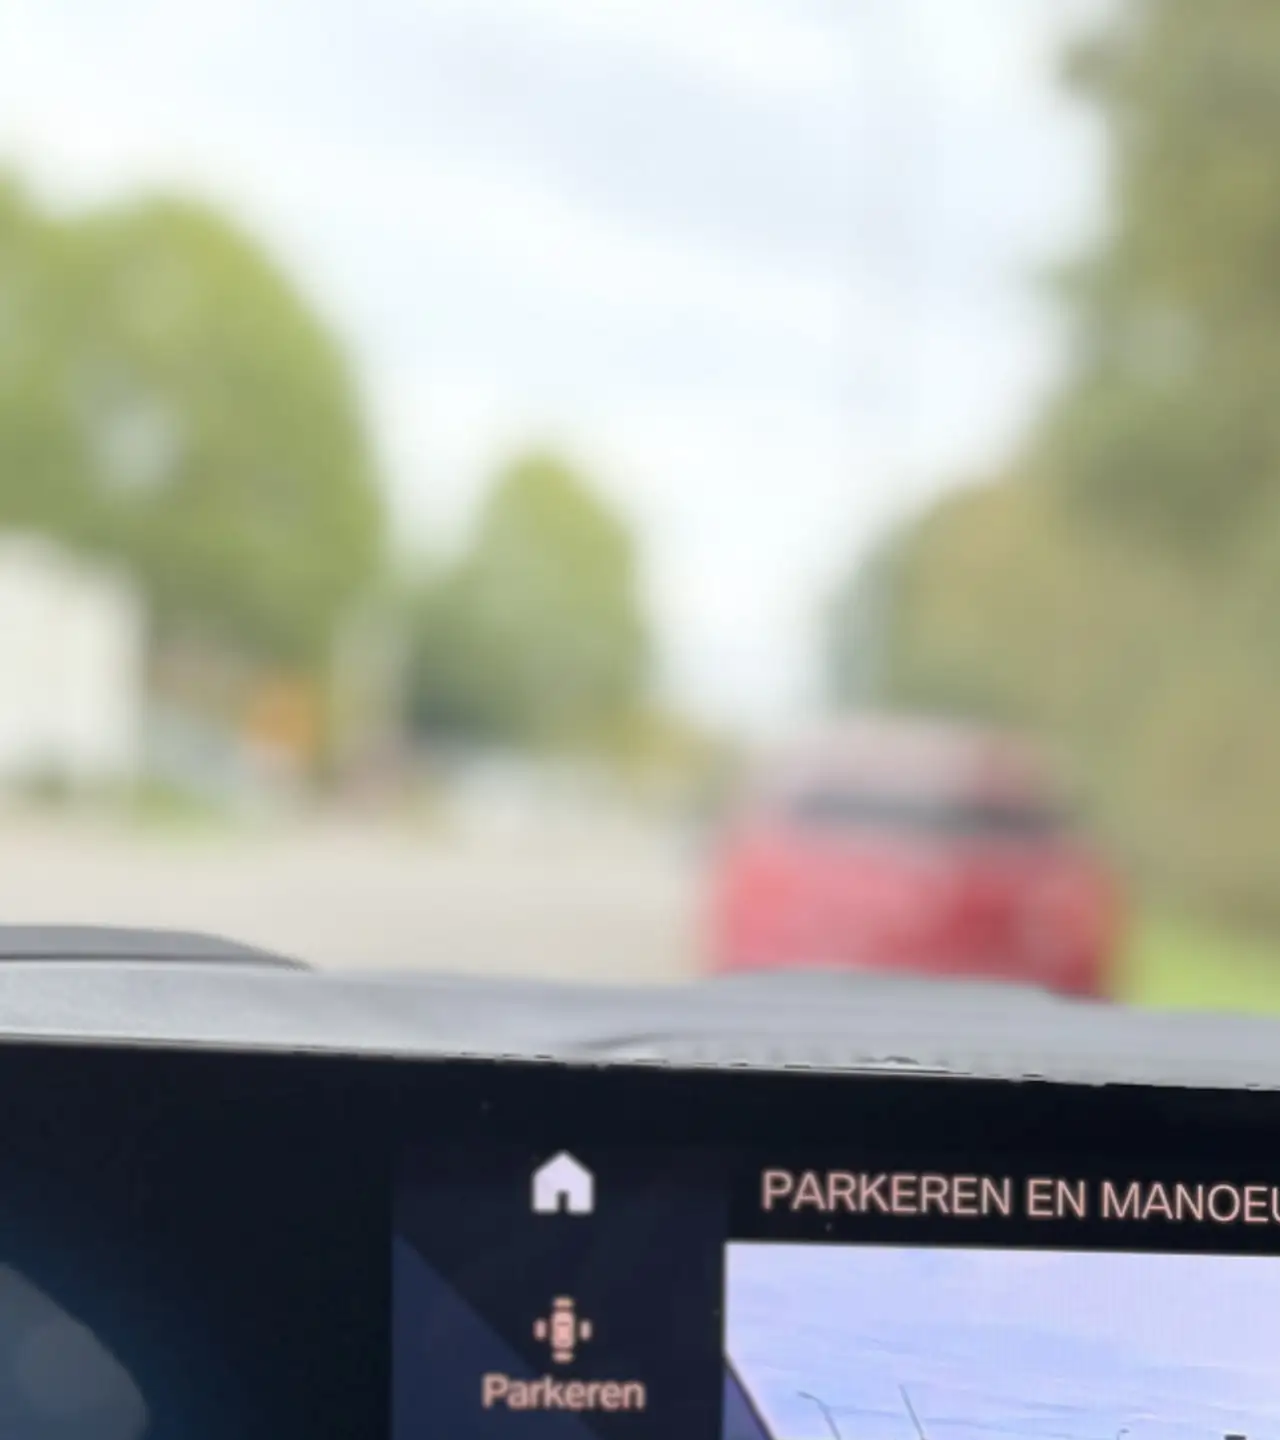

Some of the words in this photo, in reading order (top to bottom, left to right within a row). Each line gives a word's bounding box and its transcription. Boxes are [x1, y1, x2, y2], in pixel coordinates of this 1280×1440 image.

[761, 1168, 1012, 1217] PARKEREN
[1025, 1176, 1087, 1220] EN
[481, 1373, 646, 1411] Parkeren
